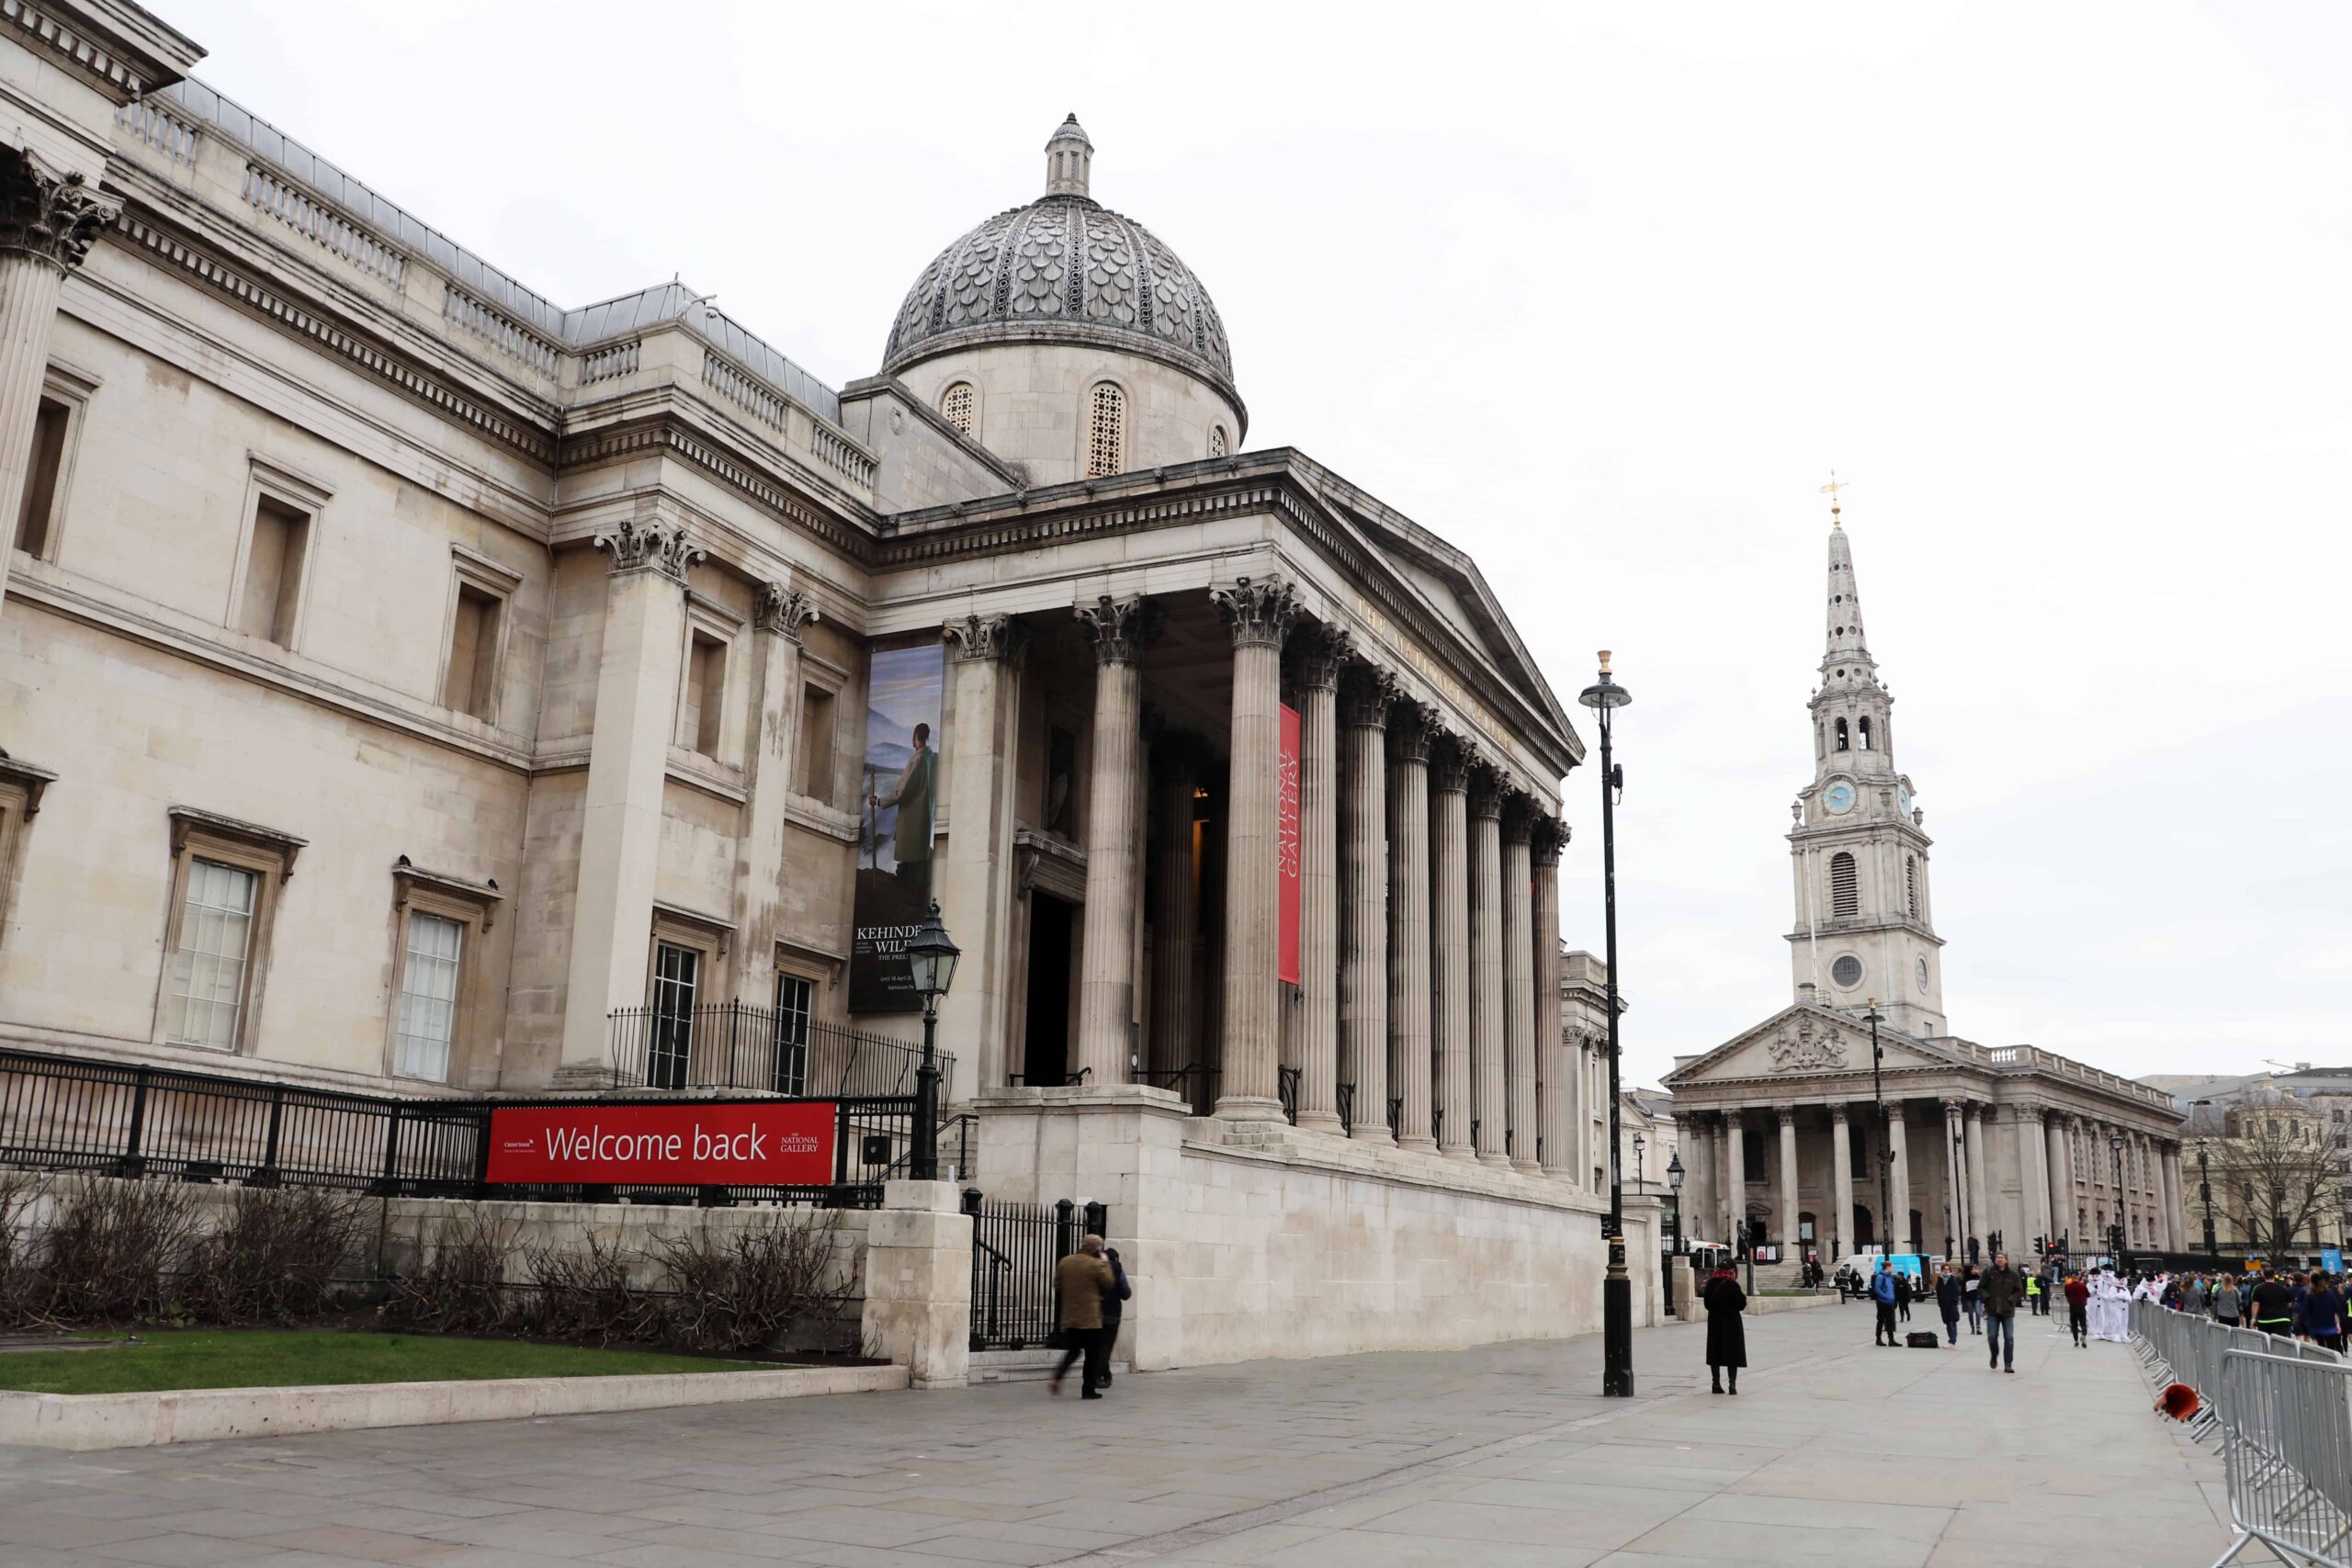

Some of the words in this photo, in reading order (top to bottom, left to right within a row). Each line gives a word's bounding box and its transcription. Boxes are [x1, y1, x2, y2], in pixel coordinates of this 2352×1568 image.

[1357, 595, 1385, 638] THE
[1395, 632, 1464, 706] NATIONAL
[1287, 750, 1297, 878] GALLERY
[546, 1124, 682, 1161] Welcome
[693, 1122, 768, 1161] back
[781, 1136, 820, 1145] NATIONAL
[781, 1145, 819, 1153] GALLERY
